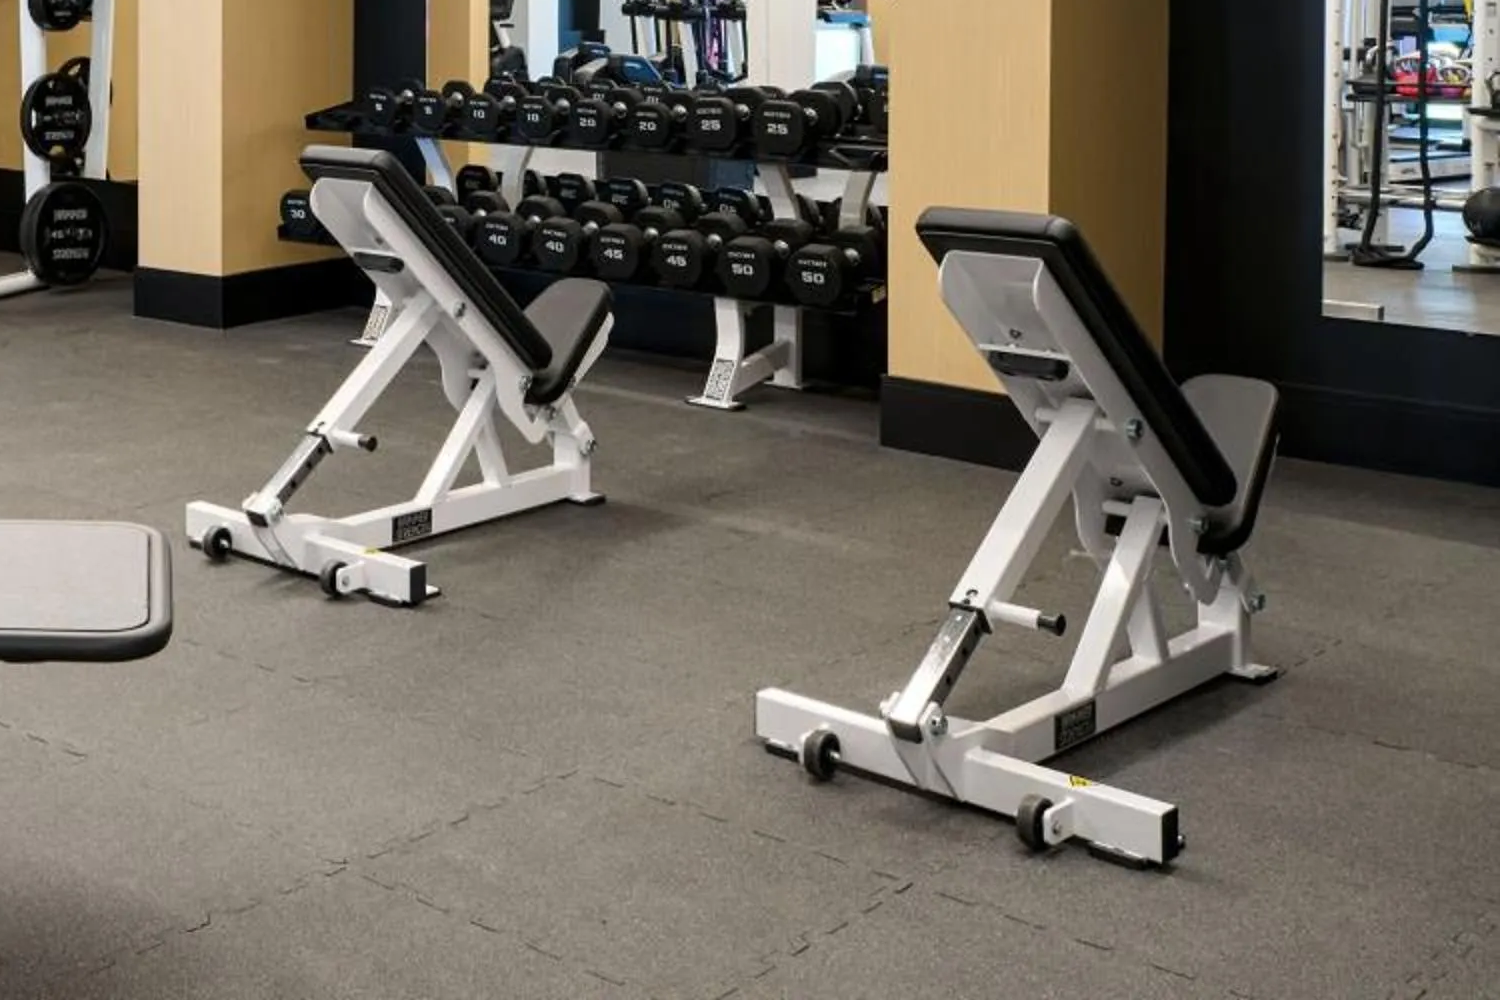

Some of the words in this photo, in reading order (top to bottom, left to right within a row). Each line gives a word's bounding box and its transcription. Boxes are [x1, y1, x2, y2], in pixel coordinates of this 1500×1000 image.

[472, 109, 485, 119] 10
[579, 117, 597, 127] 20
[638, 121, 657, 131] 20
[701, 119, 721, 131] 25
[766, 123, 789, 135] 25
[488, 234, 507, 246] 40
[545, 240, 565, 254] 40
[603, 247, 623, 260] 45
[665, 255, 687, 268] 45
[731, 263, 754, 276] 50
[801, 271, 825, 285] 50
